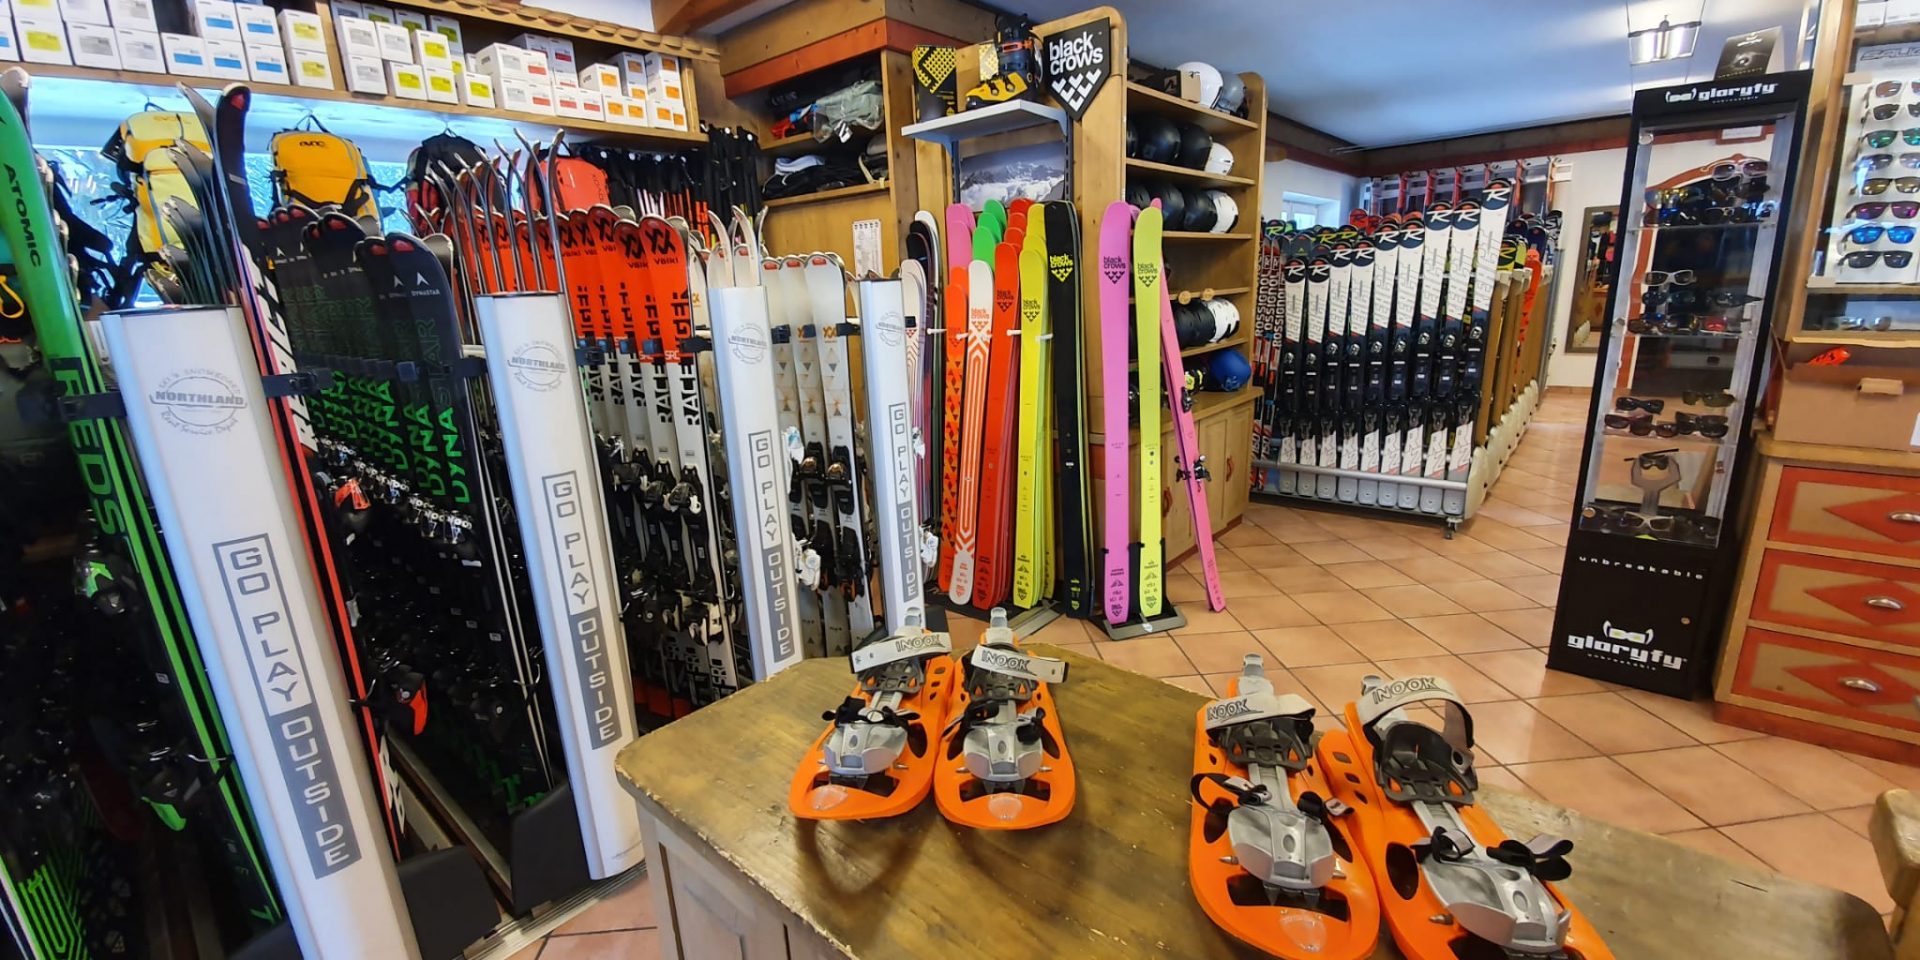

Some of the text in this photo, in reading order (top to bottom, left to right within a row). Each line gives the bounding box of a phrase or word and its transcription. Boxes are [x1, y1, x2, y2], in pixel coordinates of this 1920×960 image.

[1049, 31, 1094, 61] black
[1050, 47, 1104, 75] crows
[1698, 83, 1778, 102] gloryfy
[3, 163, 42, 267] ATOMIC
[1264, 267, 1279, 331] OSSIGNOL
[512, 356, 566, 369] NORTHLAND
[155, 391, 245, 406] NORTHLAND
[53, 369, 127, 536] REDS
[893, 409, 917, 597] GO PLAY OUTSIDE
[756, 438, 792, 656] GO PLAY OUTSIDE
[1579, 556, 1703, 580] unbreakable
[553, 481, 616, 741] GO PLAY OUTSIDE
[896, 634, 942, 652] INOOK
[1567, 634, 1684, 670] gloryfy
[982, 650, 1031, 671] INOOK
[1373, 677, 1441, 705] INOOK
[229, 547, 350, 868] GO PLAY OUTSIDE
